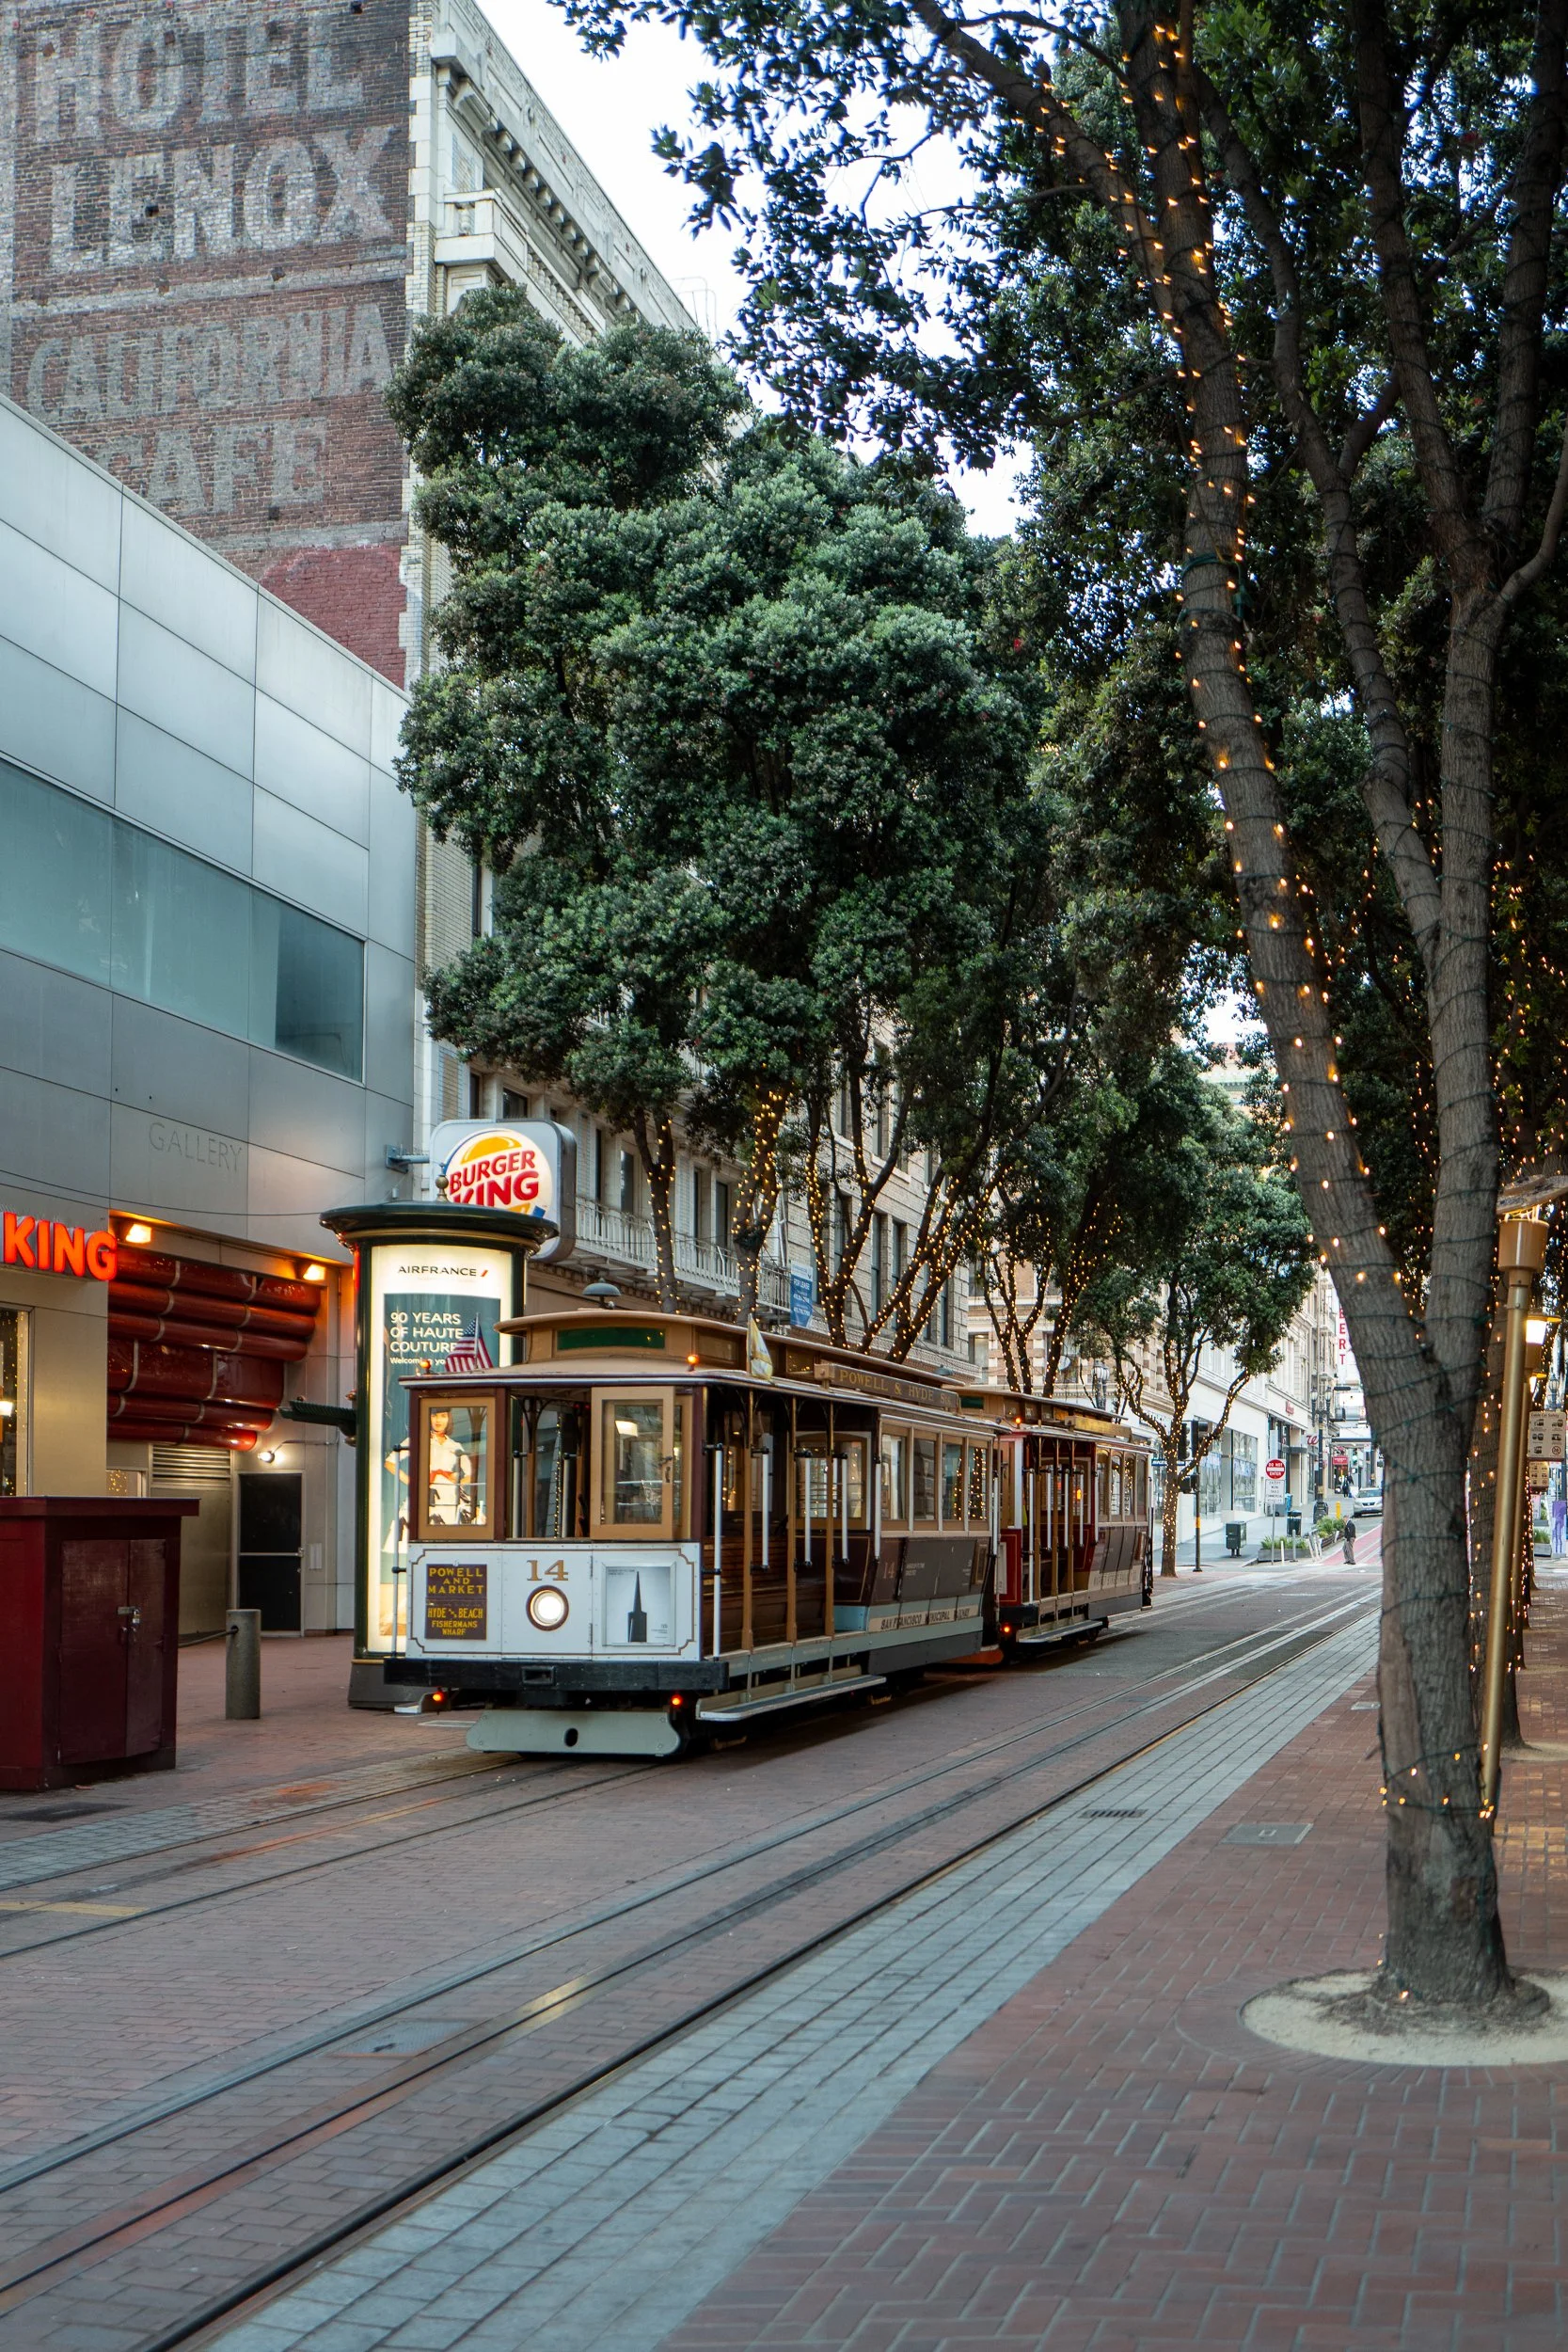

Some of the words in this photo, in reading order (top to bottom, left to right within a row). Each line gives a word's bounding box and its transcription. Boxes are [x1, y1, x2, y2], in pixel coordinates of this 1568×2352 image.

[34, 11, 365, 142] HOTEL
[50, 124, 396, 274] LENOX
[25, 303, 394, 421] CALIFORNIA
[94, 417, 326, 515] CAFE
[149, 1121, 242, 1173] GALLERY
[449, 1150, 536, 1196] BURGER
[3, 1211, 119, 1281] KING
[389, 1327, 409, 1338] OF
[412, 1327, 465, 1339] HAUTE
[390, 1311, 408, 1324] 90
[412, 1311, 462, 1325] YEARS
[839, 1369, 889, 1391] POWELL
[894, 1383, 903, 1395] &
[909, 1385, 934, 1401] HYDE
[429, 1567, 483, 1577] POWELL
[526, 1560, 569, 1581] 14
[882, 1562, 895, 1579] 14
[428, 1584, 484, 1595] MARKET
[428, 1608, 447, 1618] HYDE
[458, 1608, 483, 1619] BEACH
